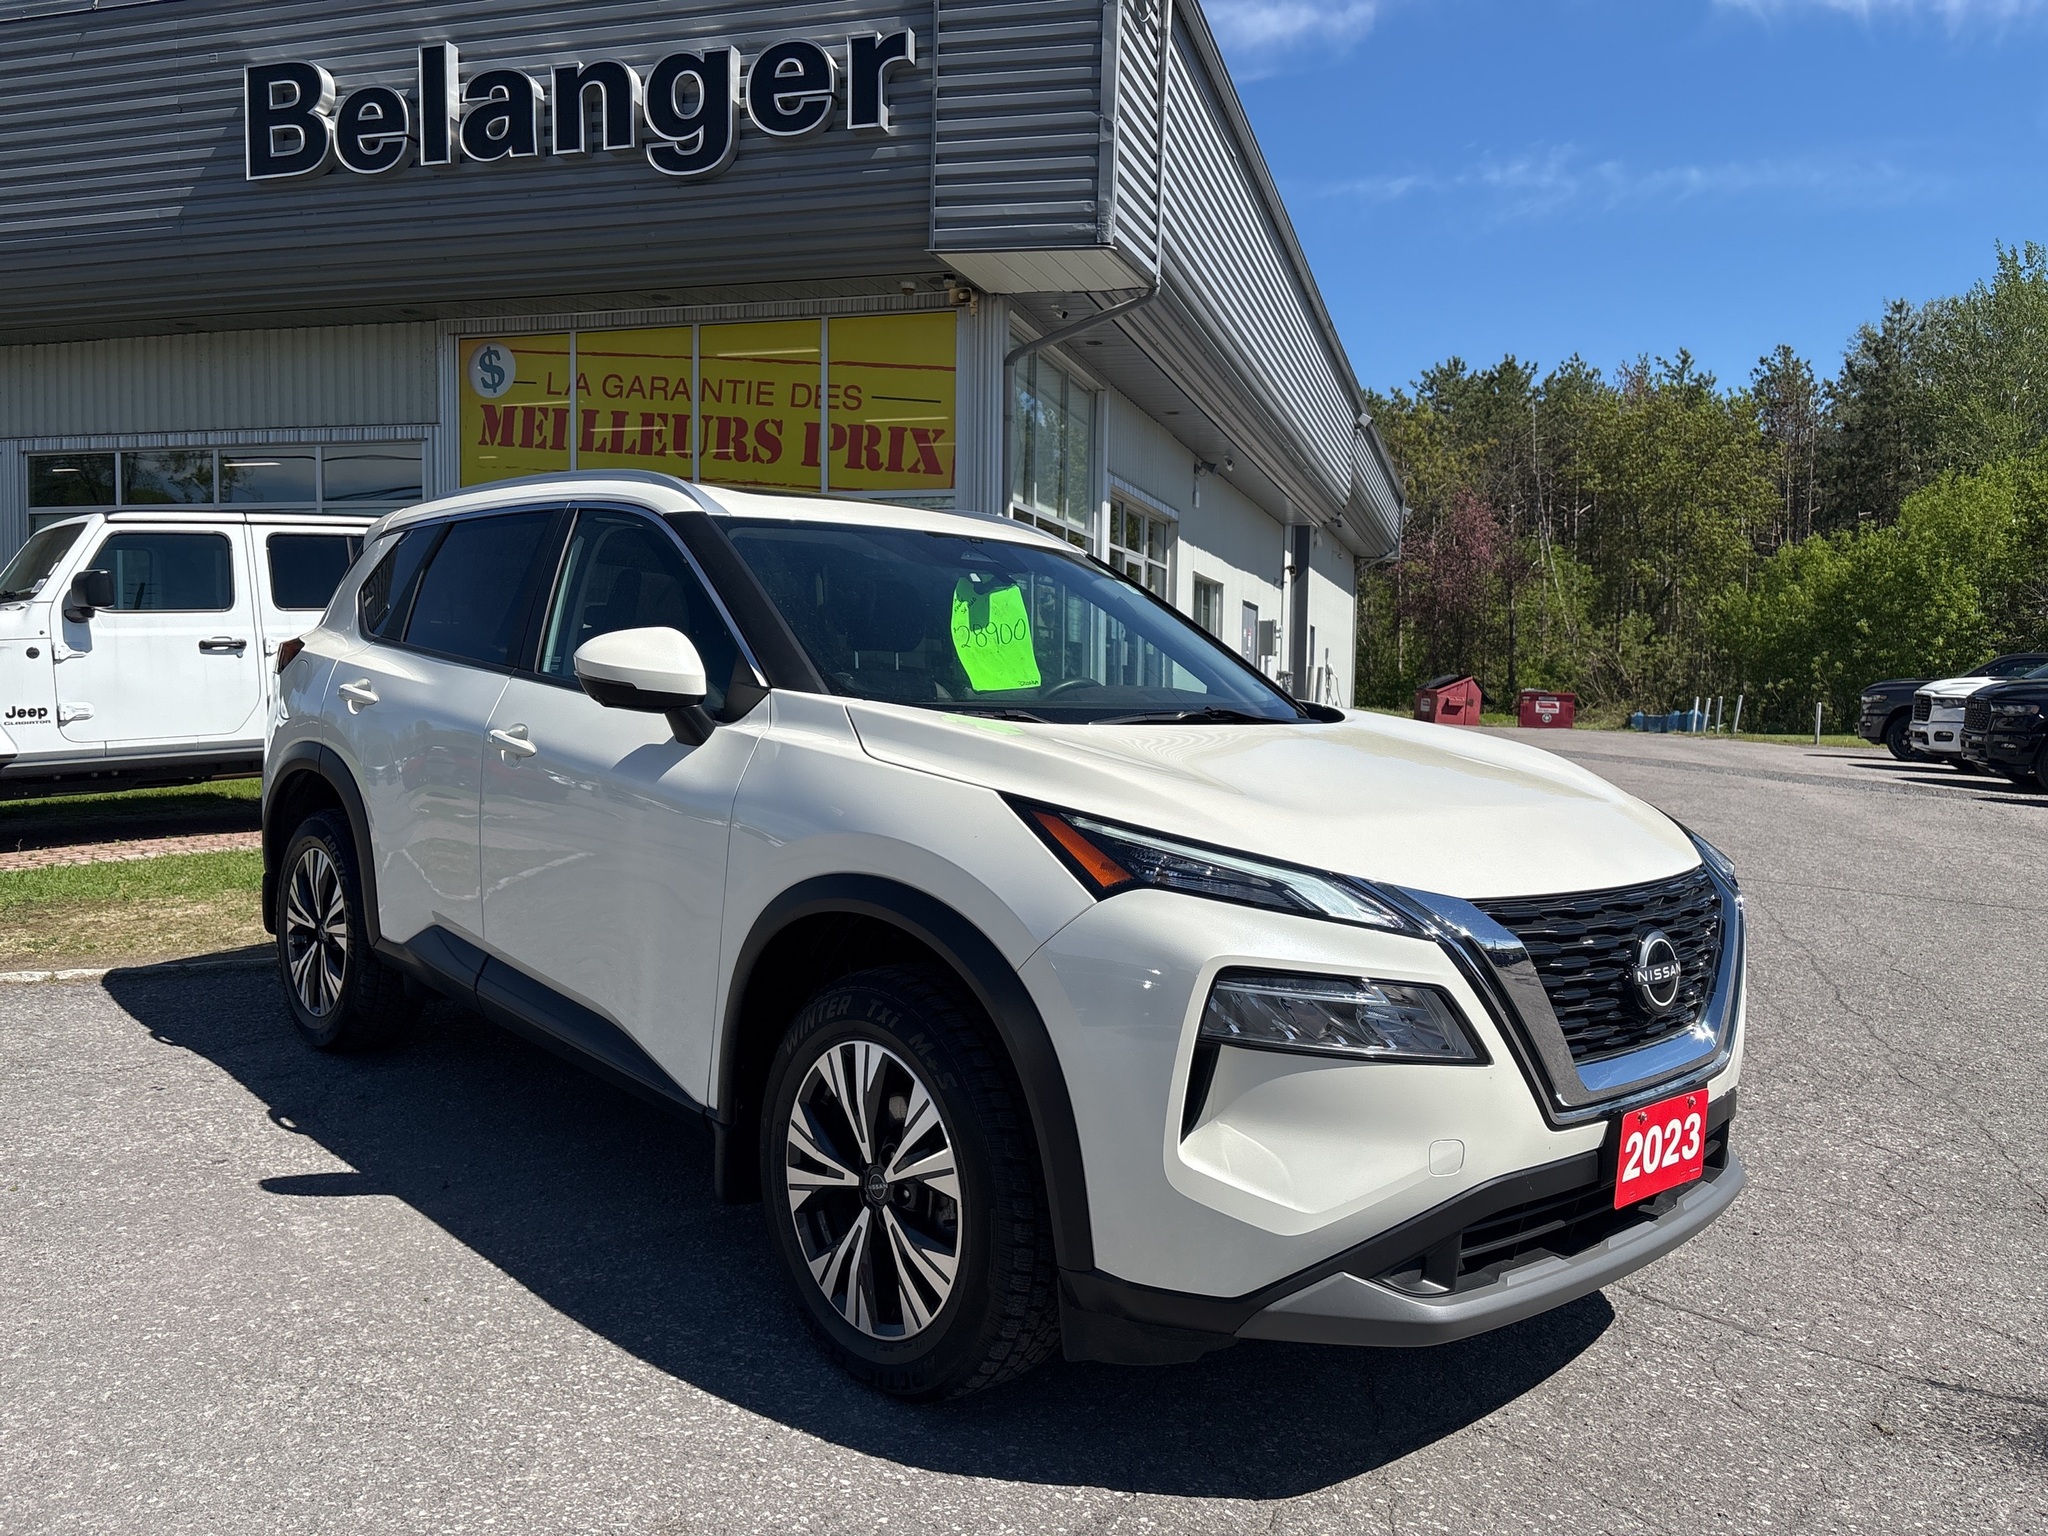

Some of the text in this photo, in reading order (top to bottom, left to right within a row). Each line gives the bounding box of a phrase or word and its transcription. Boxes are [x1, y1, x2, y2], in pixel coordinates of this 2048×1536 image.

[244, 27, 916, 183] Belanger
[546, 371, 863, 411] LA GARANTIE DES
[478, 403, 946, 475] MEILLEURS PRIX
[5, 705, 48, 719] Jeep
[1637, 961, 1681, 984] NISSAN
[786, 995, 853, 1055] WINTER
[1621, 1112, 1701, 1183] 2023
